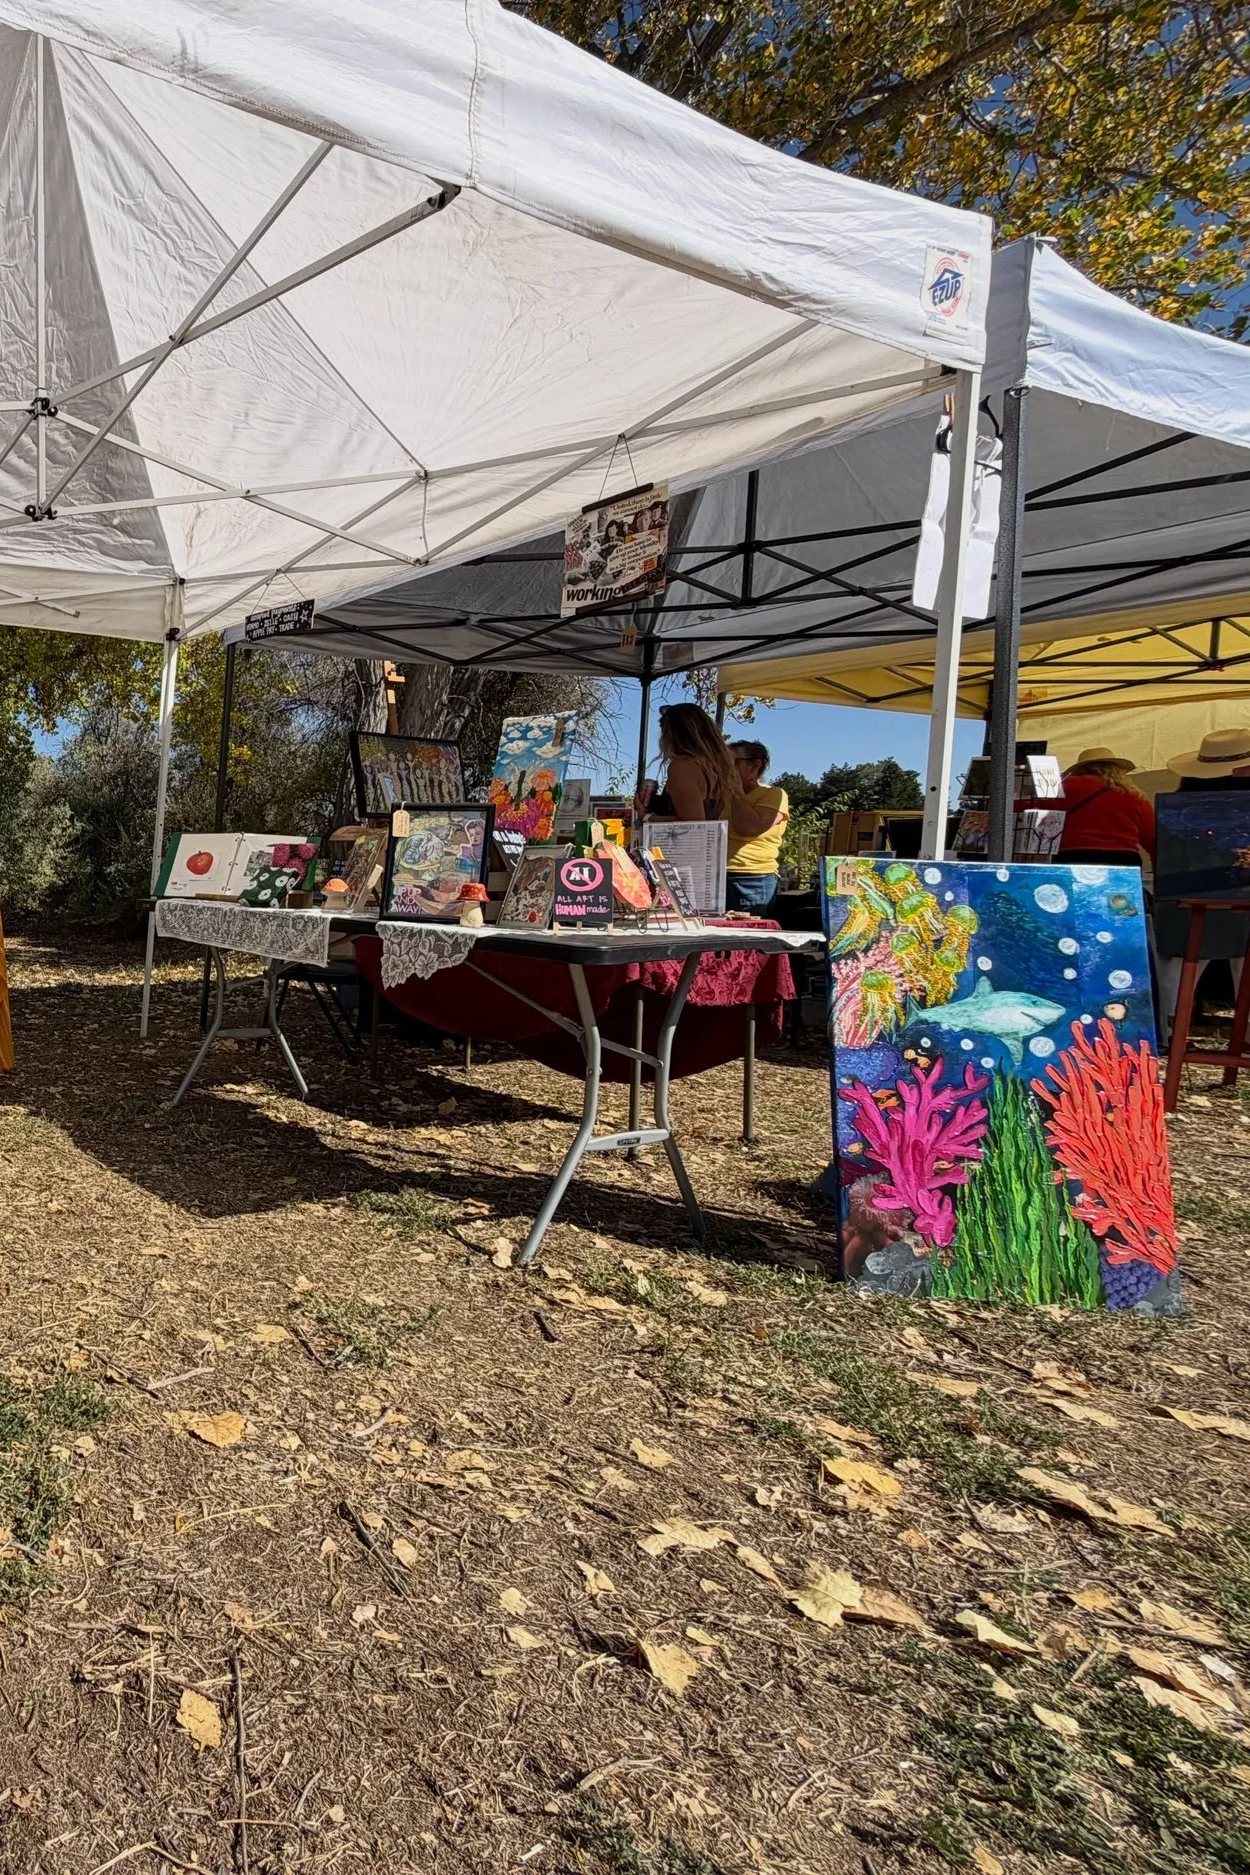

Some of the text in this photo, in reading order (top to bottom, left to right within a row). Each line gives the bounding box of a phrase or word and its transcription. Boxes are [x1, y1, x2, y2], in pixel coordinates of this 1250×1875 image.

[569, 867, 591, 881] AI
[555, 903, 610, 916] HUMAN made
